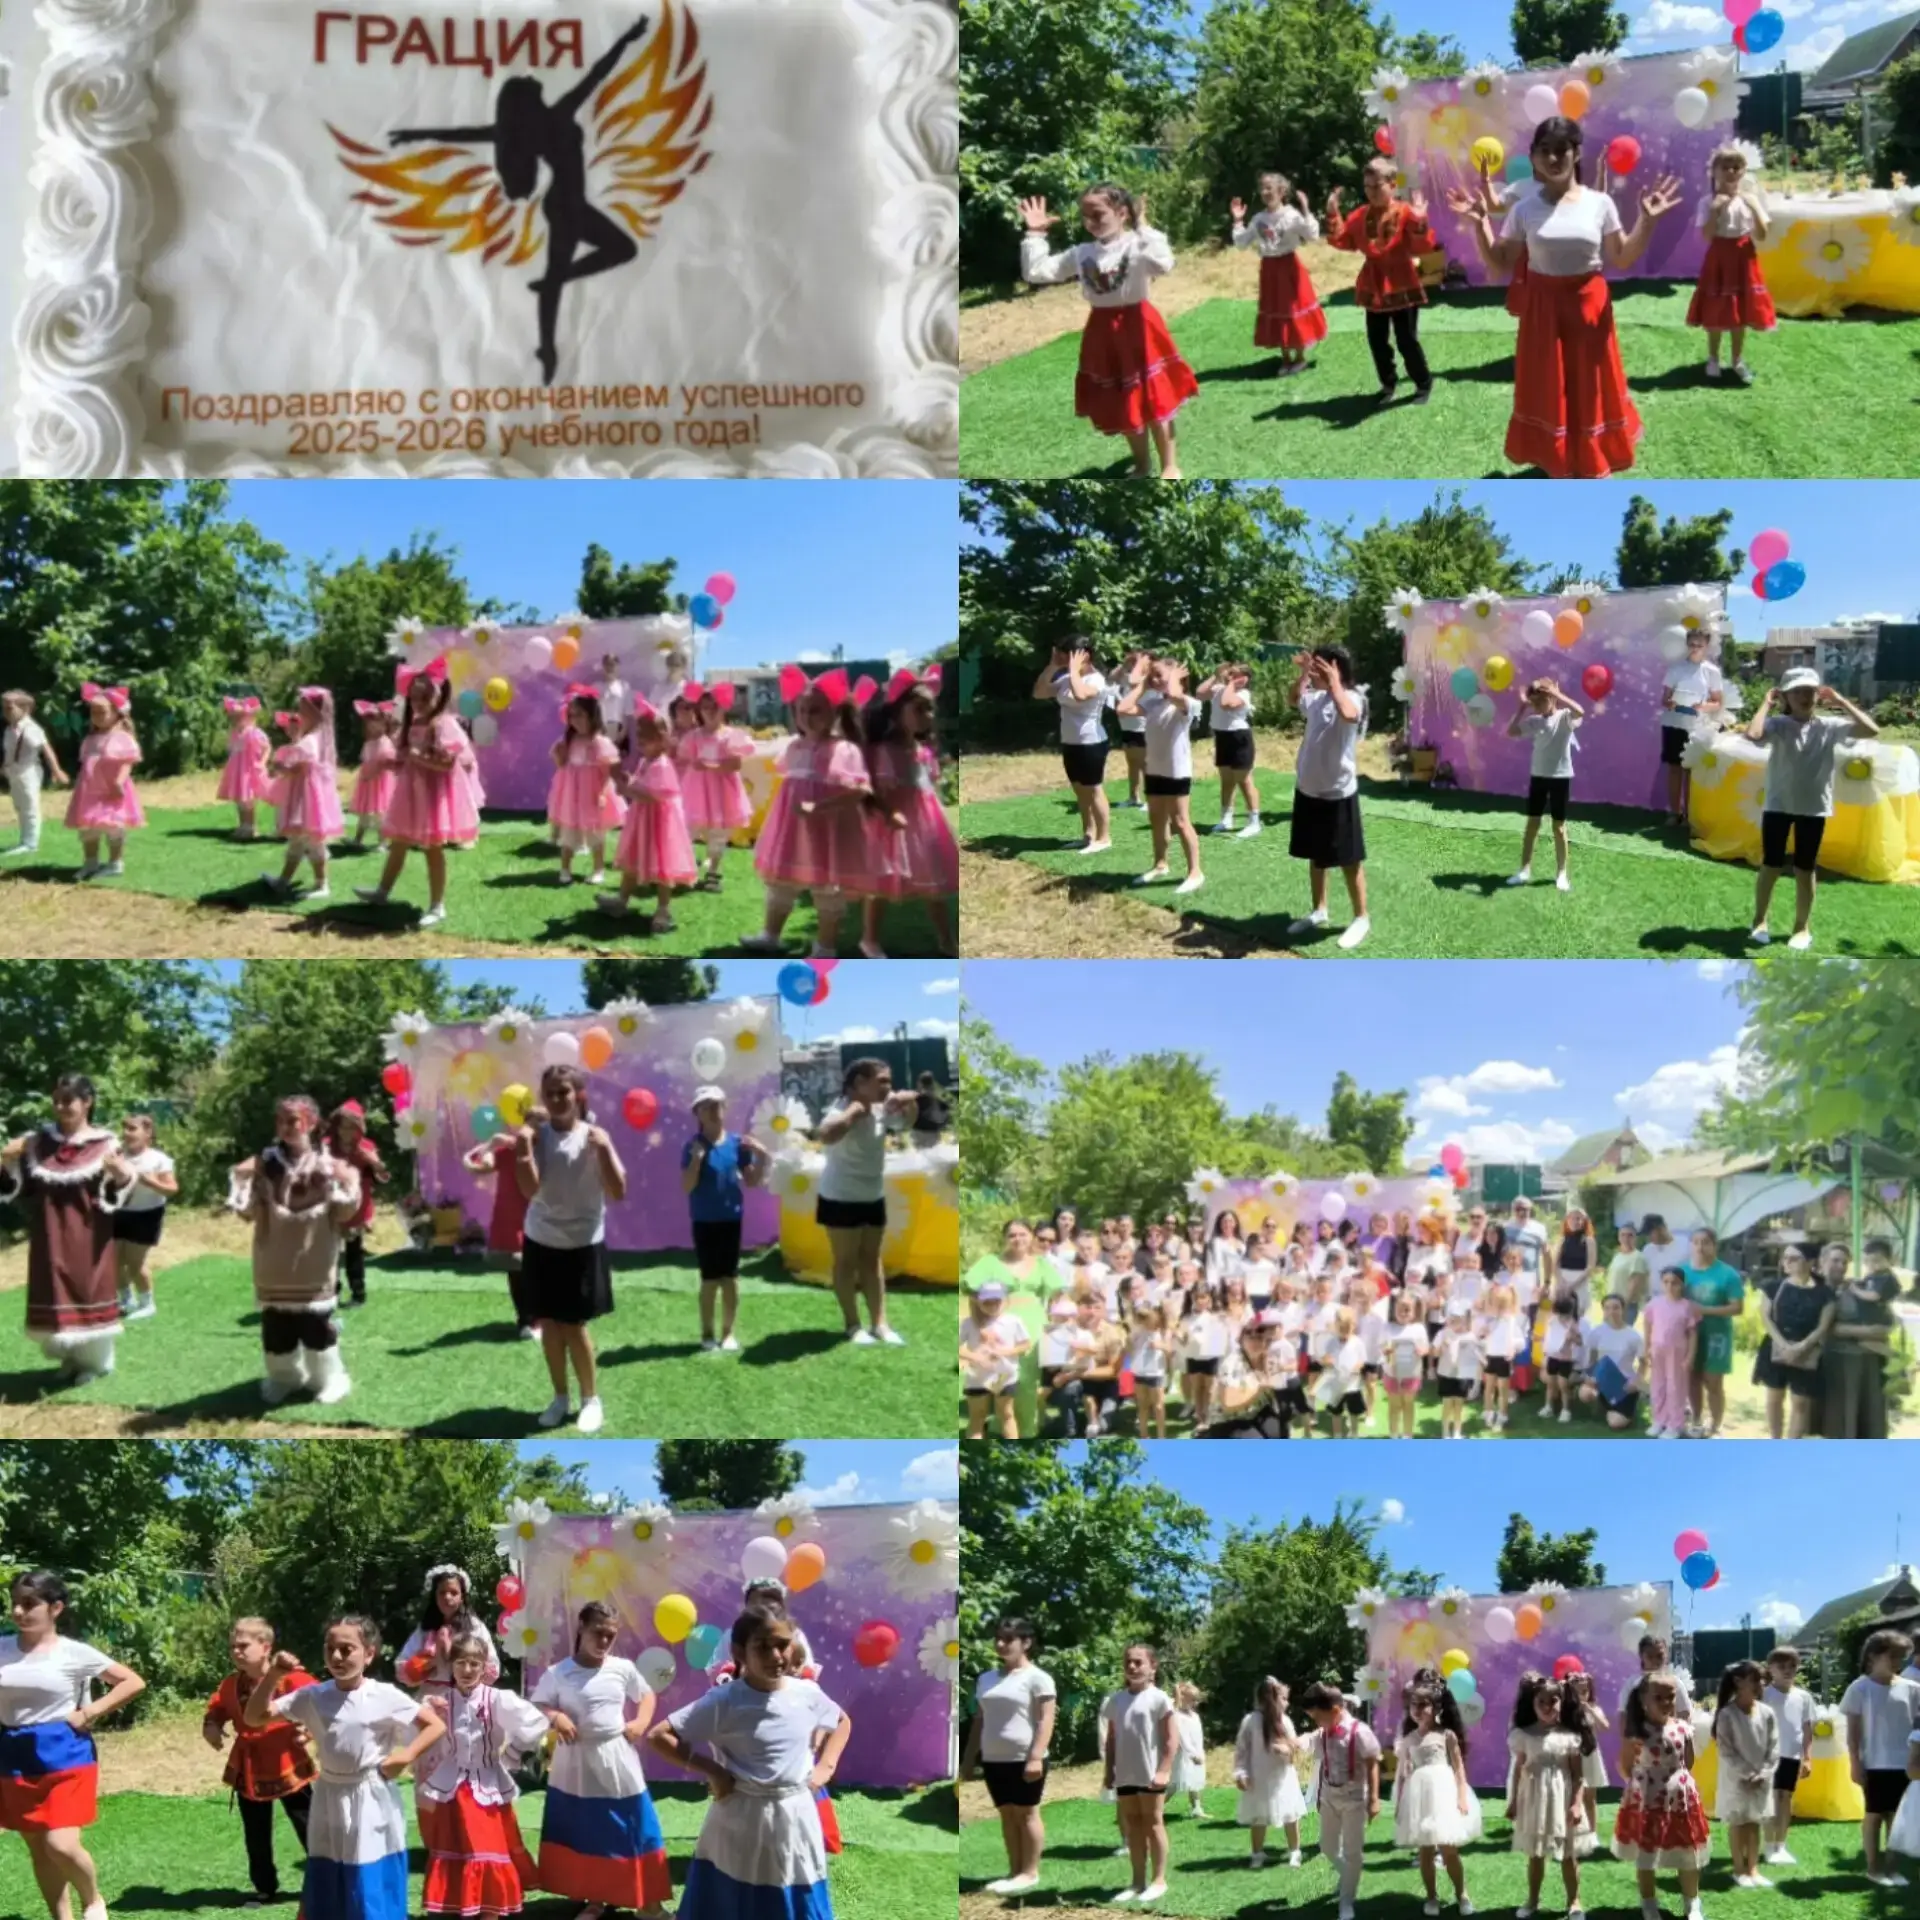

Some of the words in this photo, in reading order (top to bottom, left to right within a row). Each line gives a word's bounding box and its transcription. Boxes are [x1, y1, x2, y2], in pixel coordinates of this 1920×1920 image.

[314, 11, 584, 78] ГРАЦИЯ
[161, 386, 406, 427] Поздравляю
[418, 389, 440, 414] с
[451, 384, 670, 412] окончанием
[681, 383, 865, 416] успешного
[288, 416, 487, 455] 2025-2026
[500, 414, 662, 457] учебного
[674, 413, 762, 449] года!
